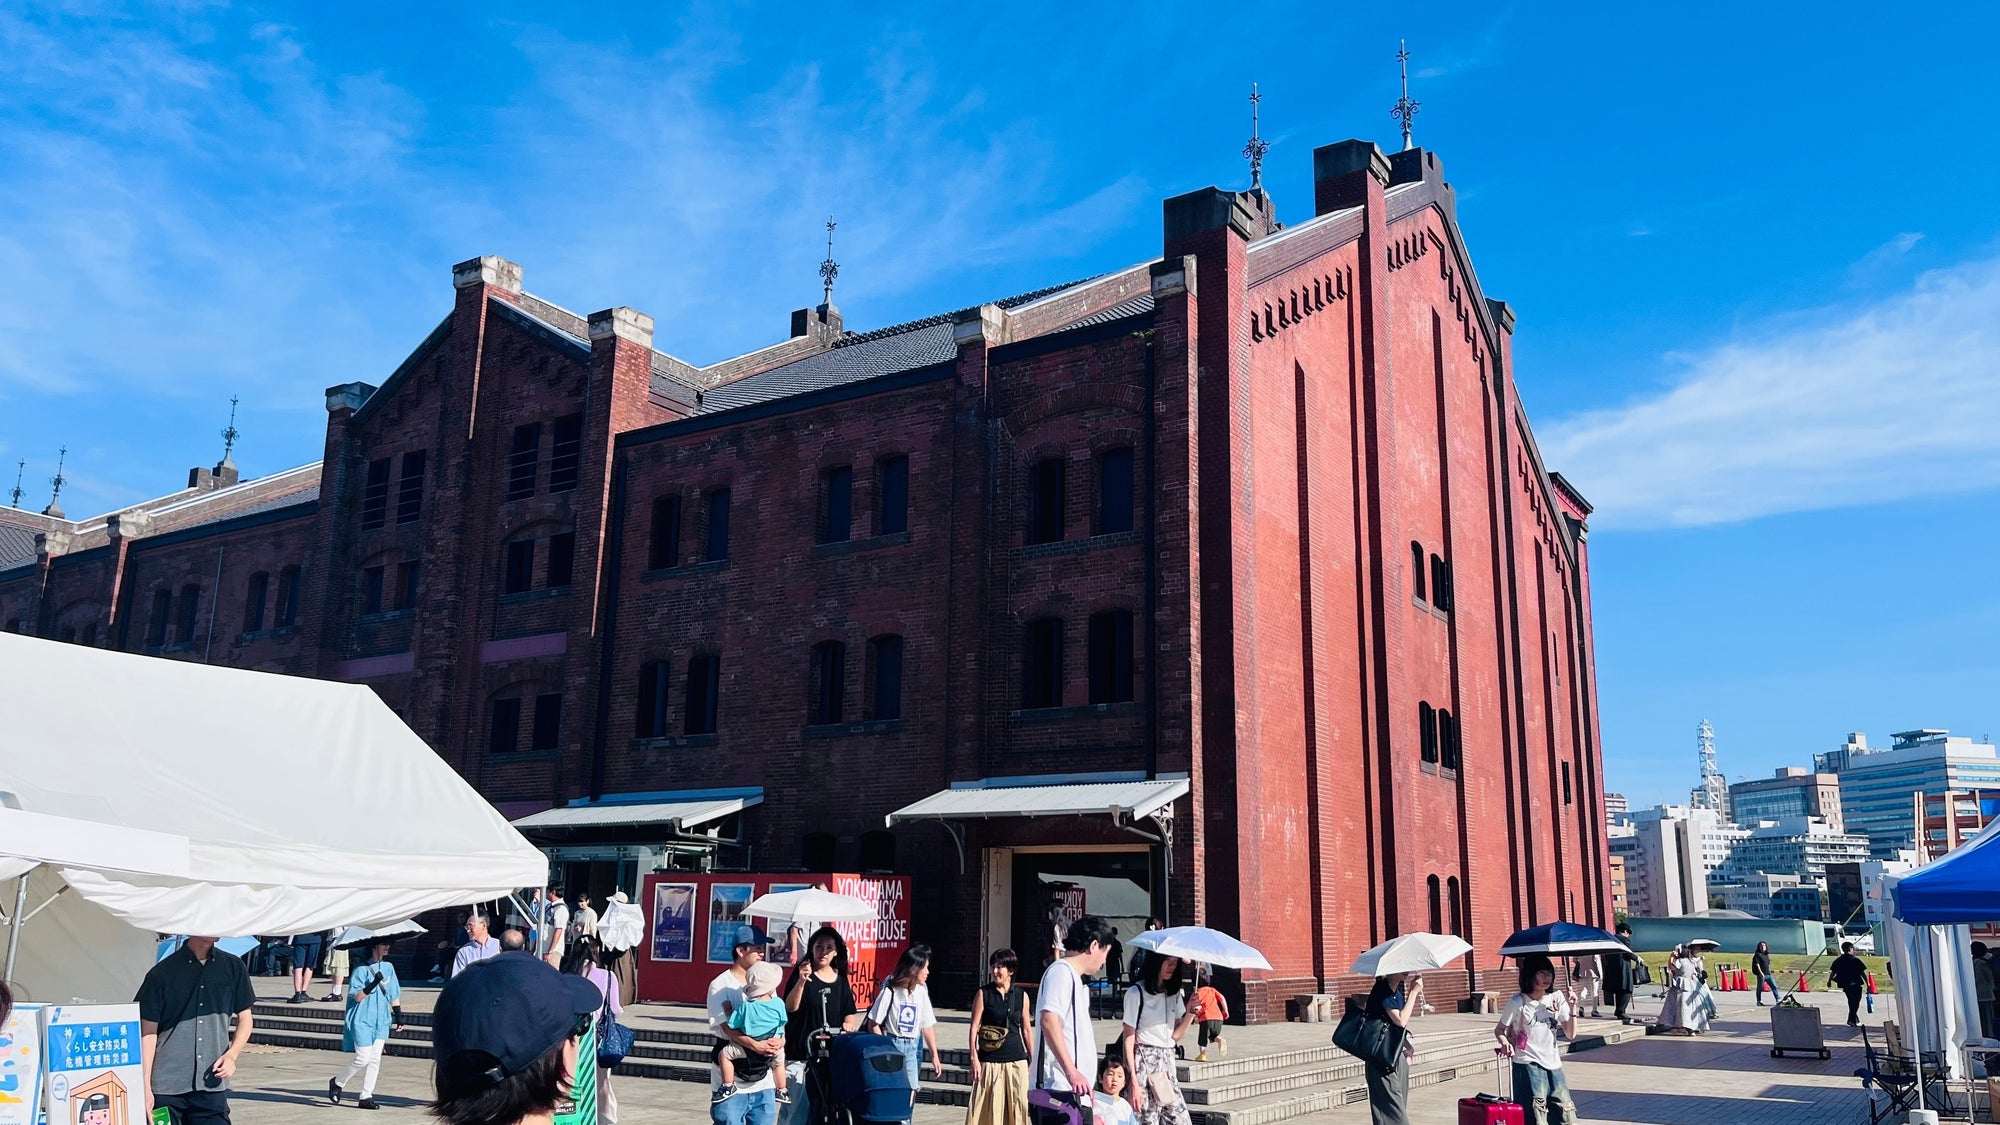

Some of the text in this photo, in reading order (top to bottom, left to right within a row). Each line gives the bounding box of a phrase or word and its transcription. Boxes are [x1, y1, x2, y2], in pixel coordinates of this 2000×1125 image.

[837, 878, 903, 900] YOKOHAMA
[836, 919, 907, 941] WAREHOUSE
[64, 1025, 127, 1039] 神奈川県
[66, 1038, 128, 1053] くらし安全防災局
[66, 1052, 129, 1068] 危機管理防災課
